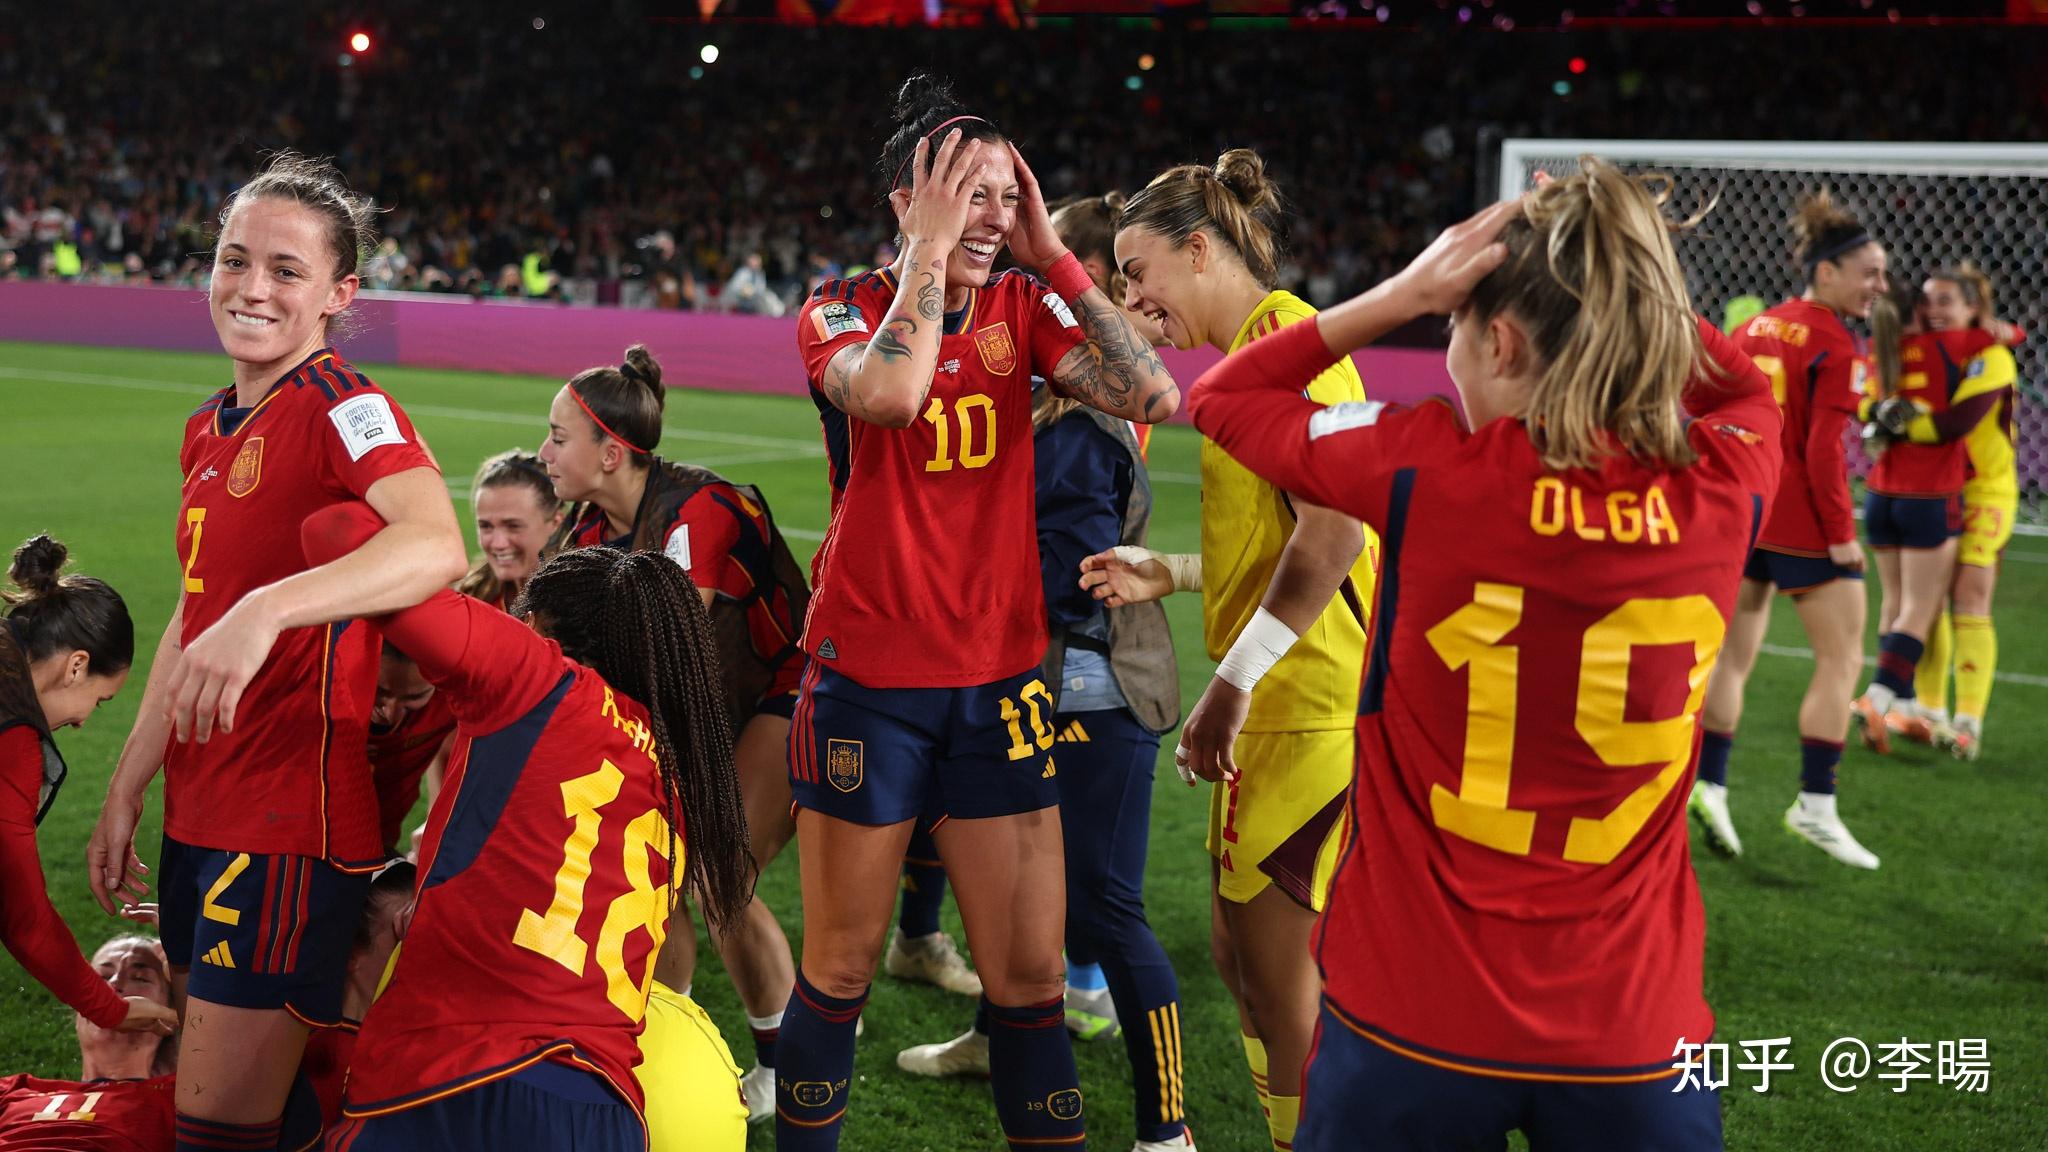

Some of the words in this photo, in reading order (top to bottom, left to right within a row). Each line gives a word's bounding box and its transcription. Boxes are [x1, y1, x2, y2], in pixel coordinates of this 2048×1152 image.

[345, 402, 378, 418] FOOTBALL
[348, 408, 382, 428] UNITES
[365, 429, 382, 439] FIFA
[923, 394, 997, 472] 10
[1530, 477, 1681, 544] OLGA
[185, 508, 207, 593] 2
[999, 679, 1055, 760] 10
[1425, 582, 1726, 865] 19
[203, 852, 251, 926] 2
[513, 759, 686, 1024] 18
[31, 1092, 104, 1122] 11
